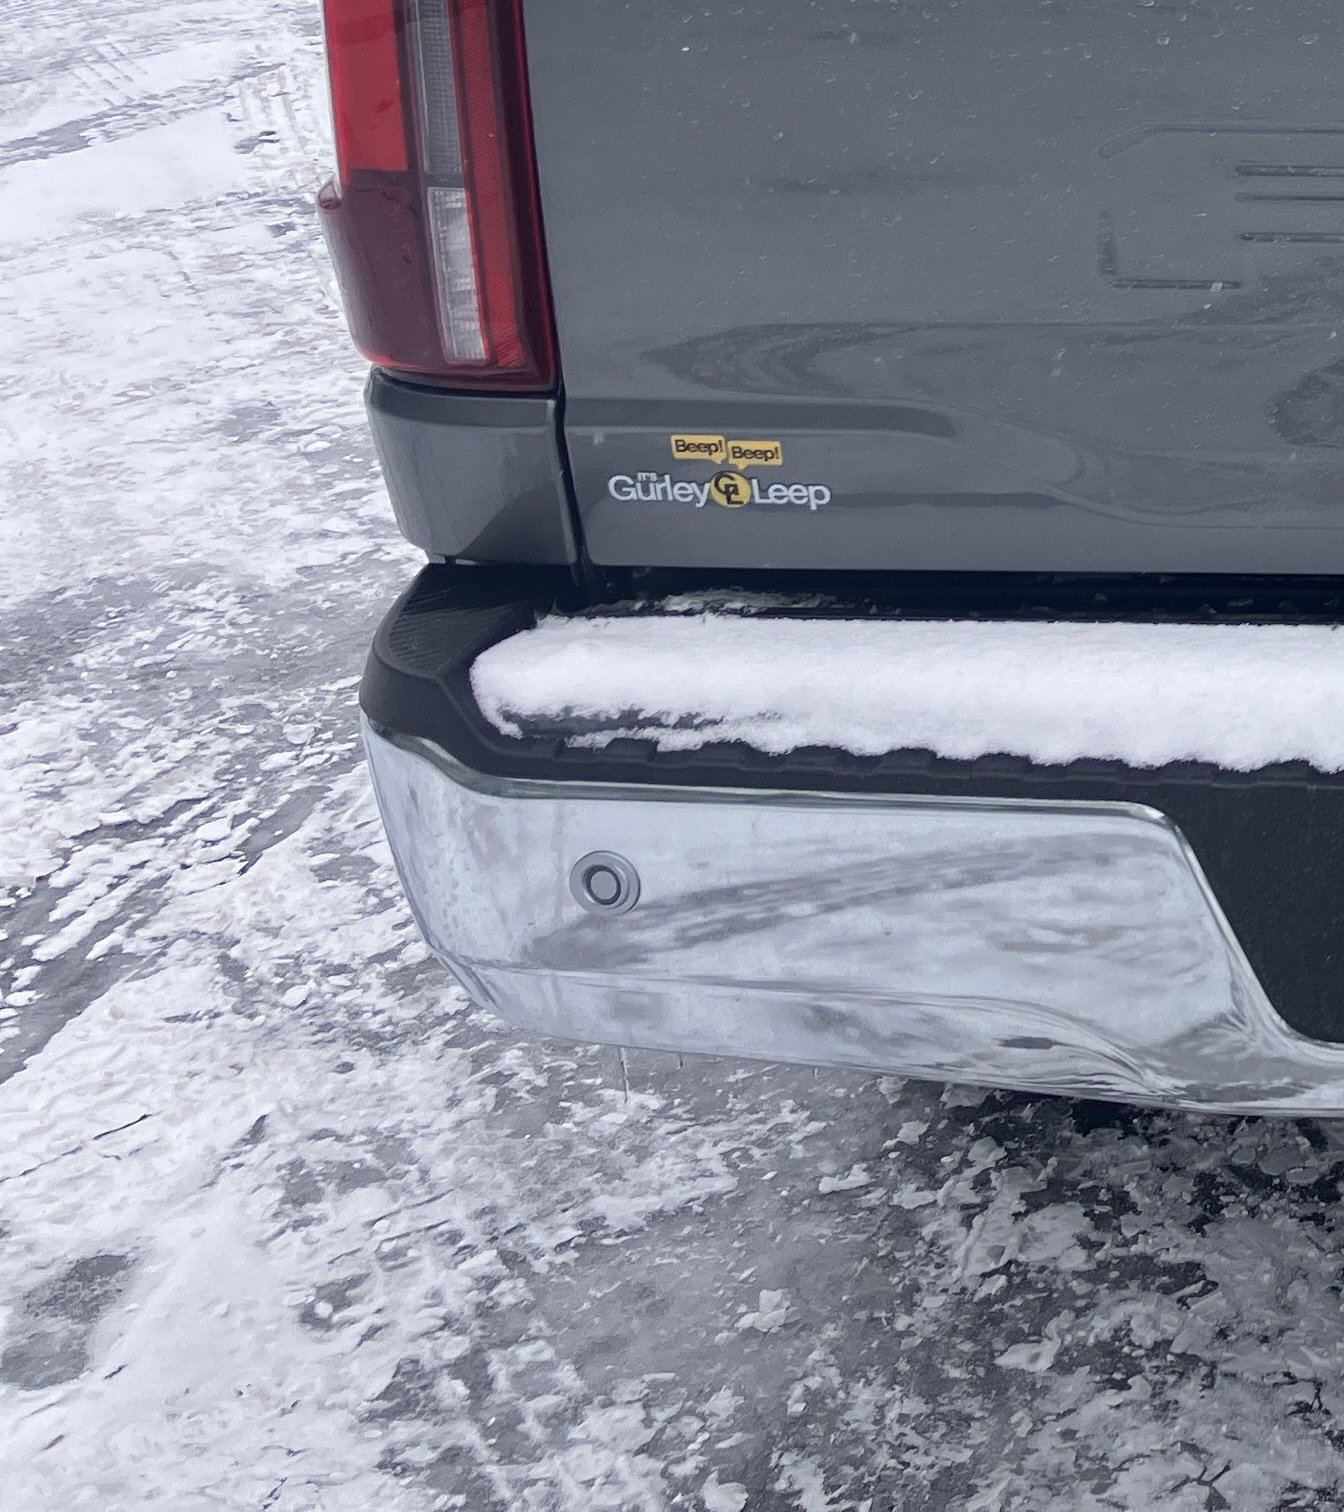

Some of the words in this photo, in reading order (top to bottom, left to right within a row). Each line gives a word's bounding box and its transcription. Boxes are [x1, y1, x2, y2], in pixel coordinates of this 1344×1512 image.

[674, 438, 723, 456] Beep!
[731, 445, 780, 463] Beep!
[608, 474, 712, 508] Gurley
[751, 478, 832, 511] Leep
